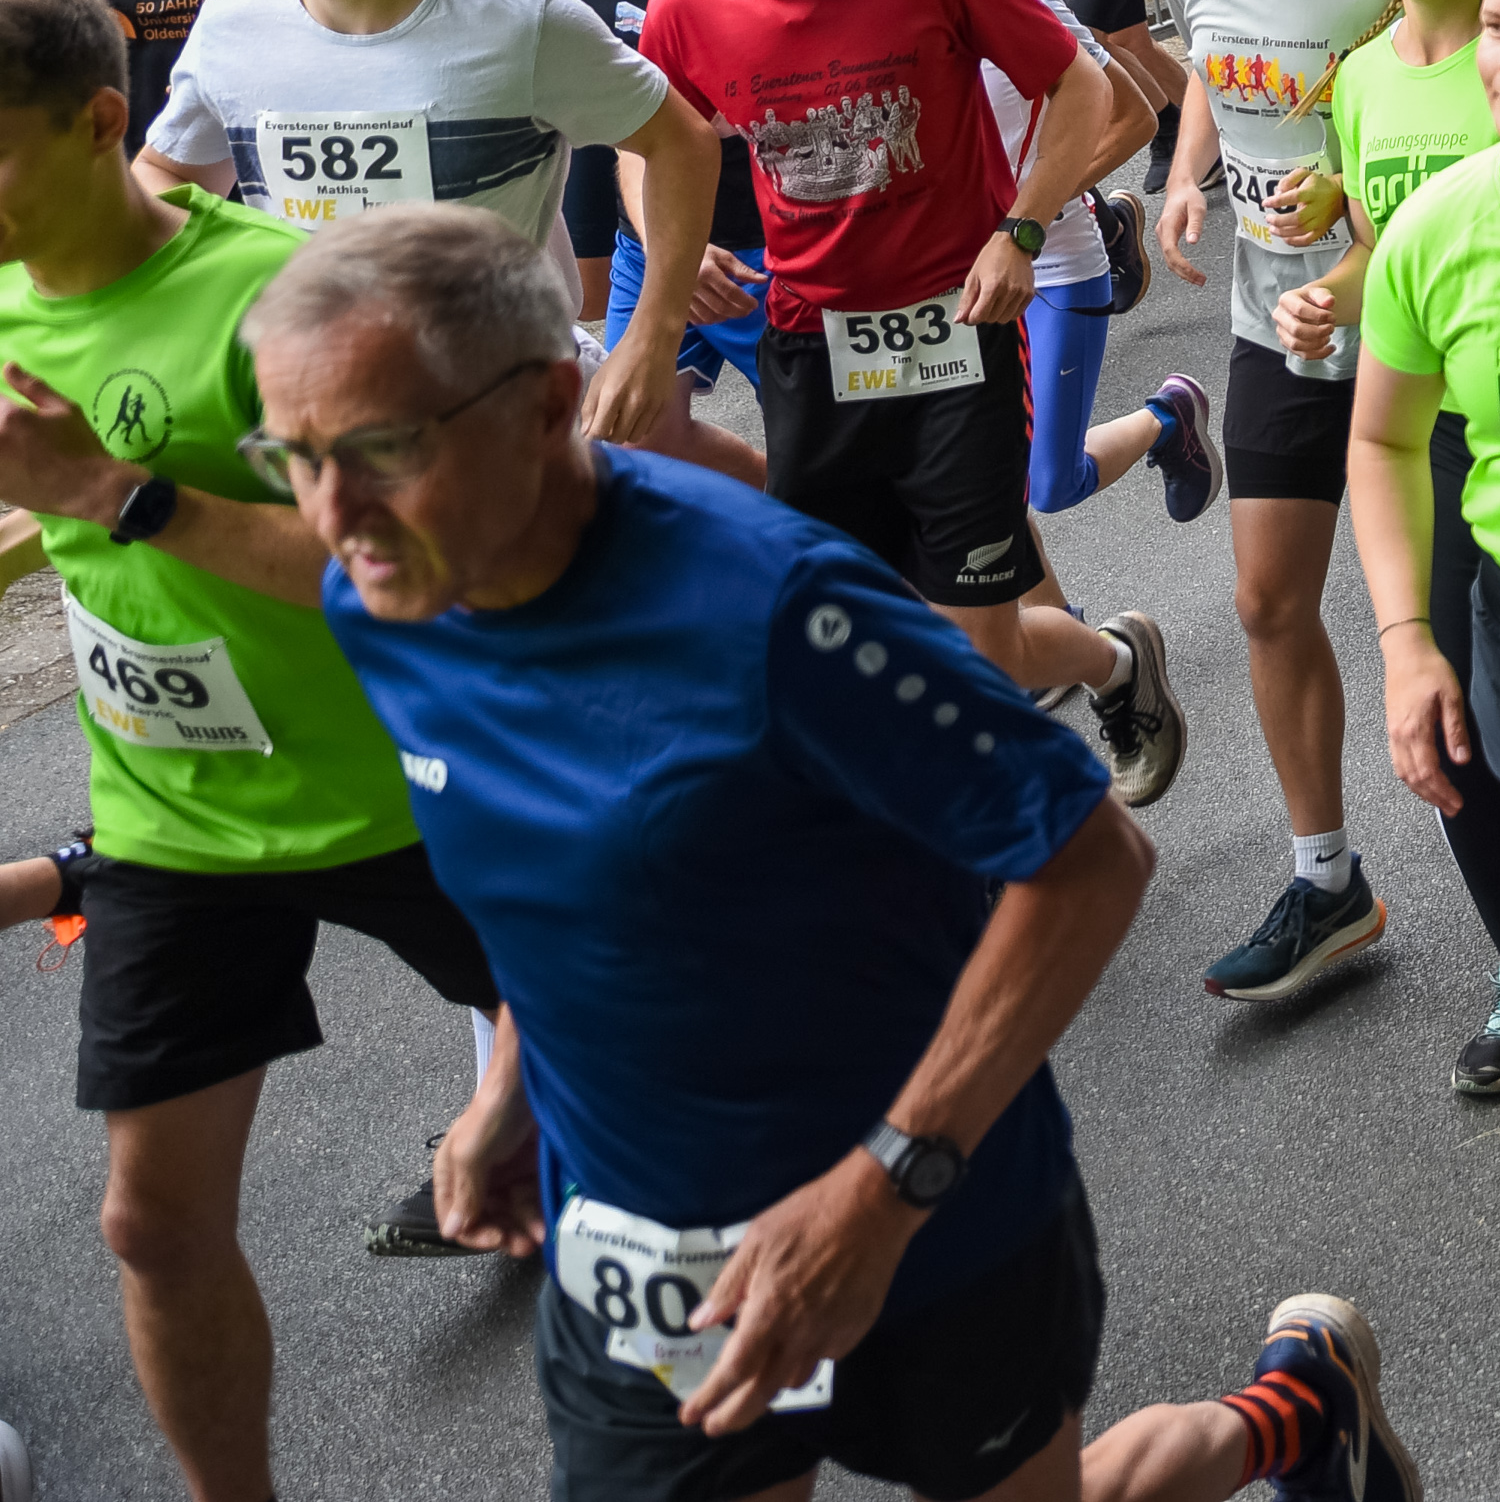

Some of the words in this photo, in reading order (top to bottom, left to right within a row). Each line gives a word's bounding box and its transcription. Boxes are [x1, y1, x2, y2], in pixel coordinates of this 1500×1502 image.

[136, 1, 155, 14] 50
[1211, 32, 1260, 47] Everstener
[1262, 35, 1331, 50] Brunnenlauf
[264, 120, 330, 131] Everstener
[333, 118, 414, 131] Brunnenlauf
[281, 134, 403, 182] 582
[1365, 133, 1469, 158] planungsgruppe
[316, 184, 369, 196] Mathias
[1367, 155, 1440, 220] grü
[283, 197, 337, 221] EWE
[1242, 214, 1273, 245] EWE
[845, 303, 952, 354] 583
[891, 355, 913, 365] Tim
[847, 368, 897, 392] EWE
[918, 358, 968, 381] bruns
[956, 574, 976, 584] ALL
[978, 568, 1015, 584] BLACKS
[88, 642, 210, 710] 469
[95, 697, 150, 739] EWE
[174, 719, 249, 741] bruns
[593, 1254, 706, 1338] 80
